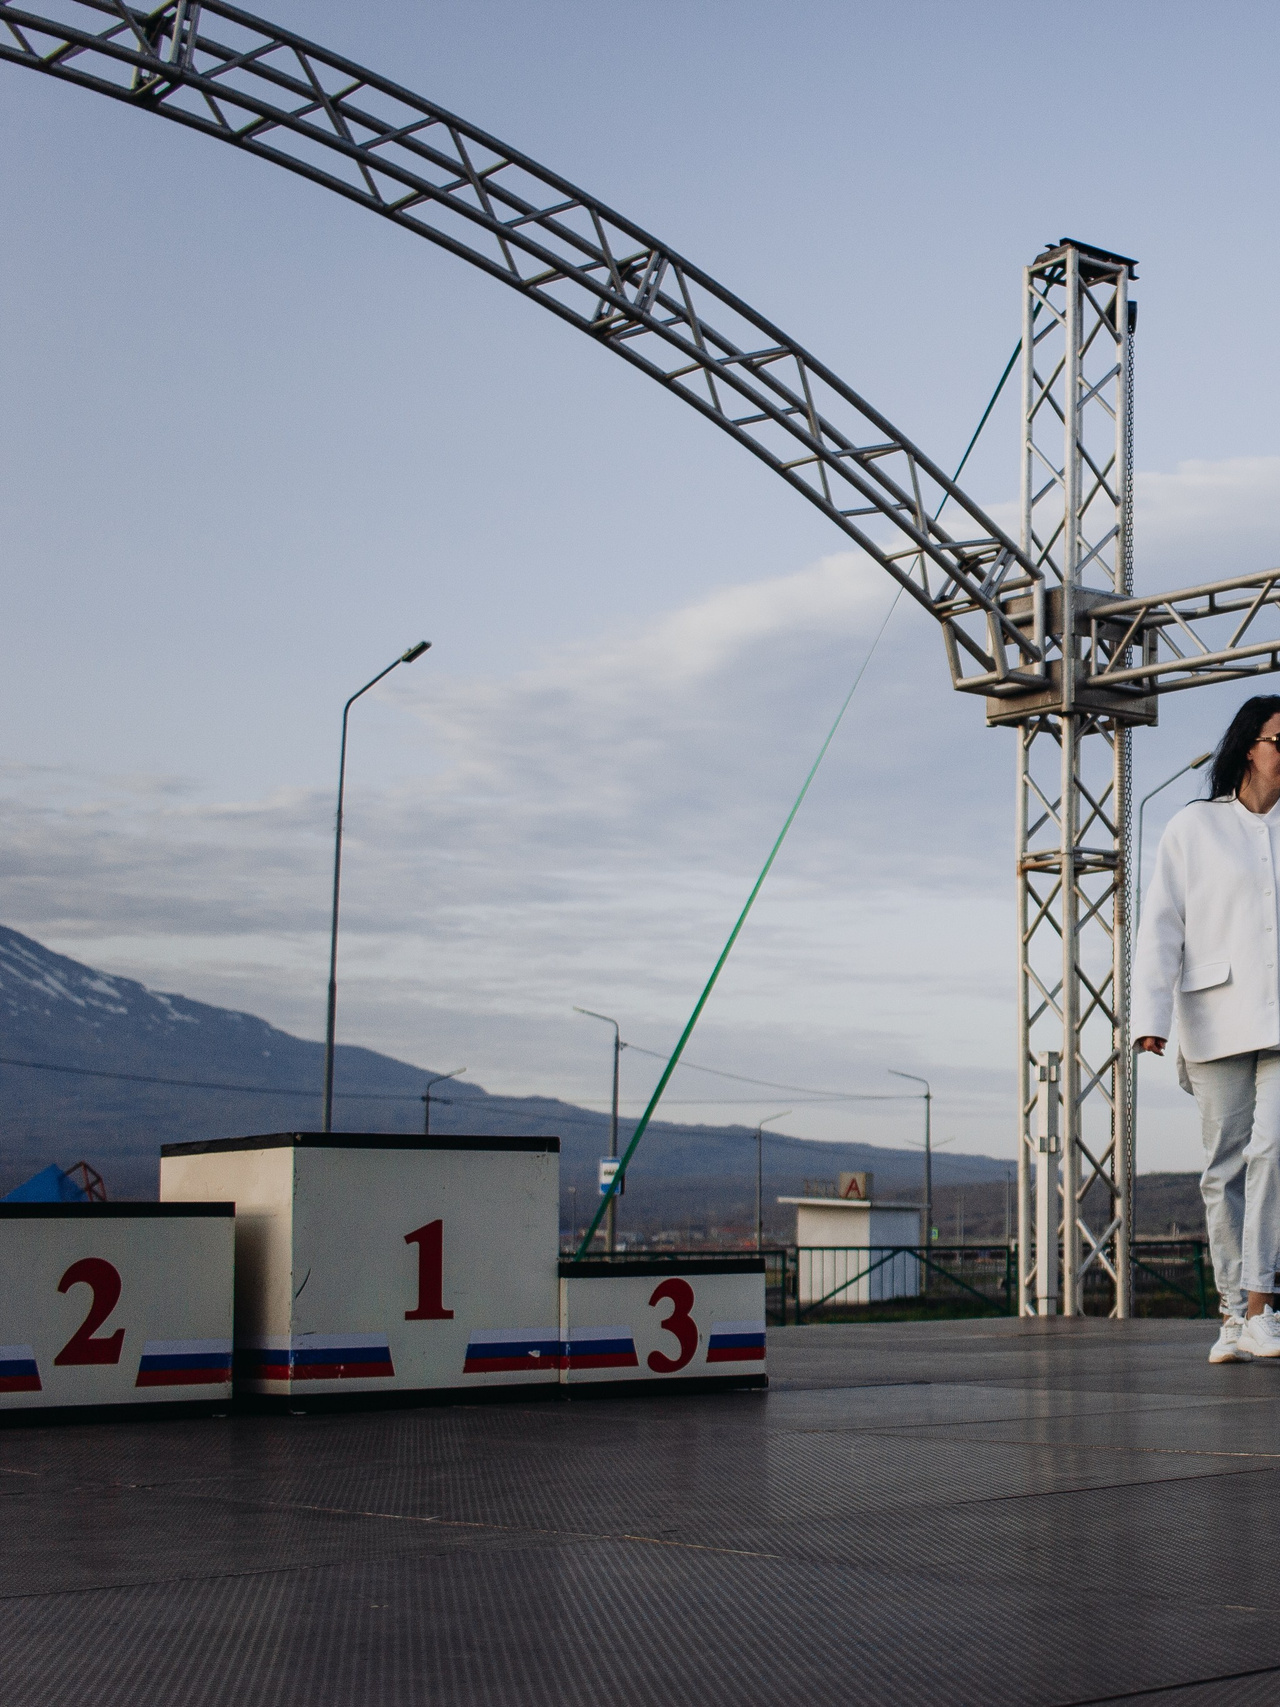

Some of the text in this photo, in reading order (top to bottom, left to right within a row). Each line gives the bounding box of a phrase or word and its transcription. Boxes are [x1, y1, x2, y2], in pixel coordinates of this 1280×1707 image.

[54, 1257, 126, 1366] 2
[404, 1219, 454, 1320] 1
[647, 1278, 699, 1374] 3
